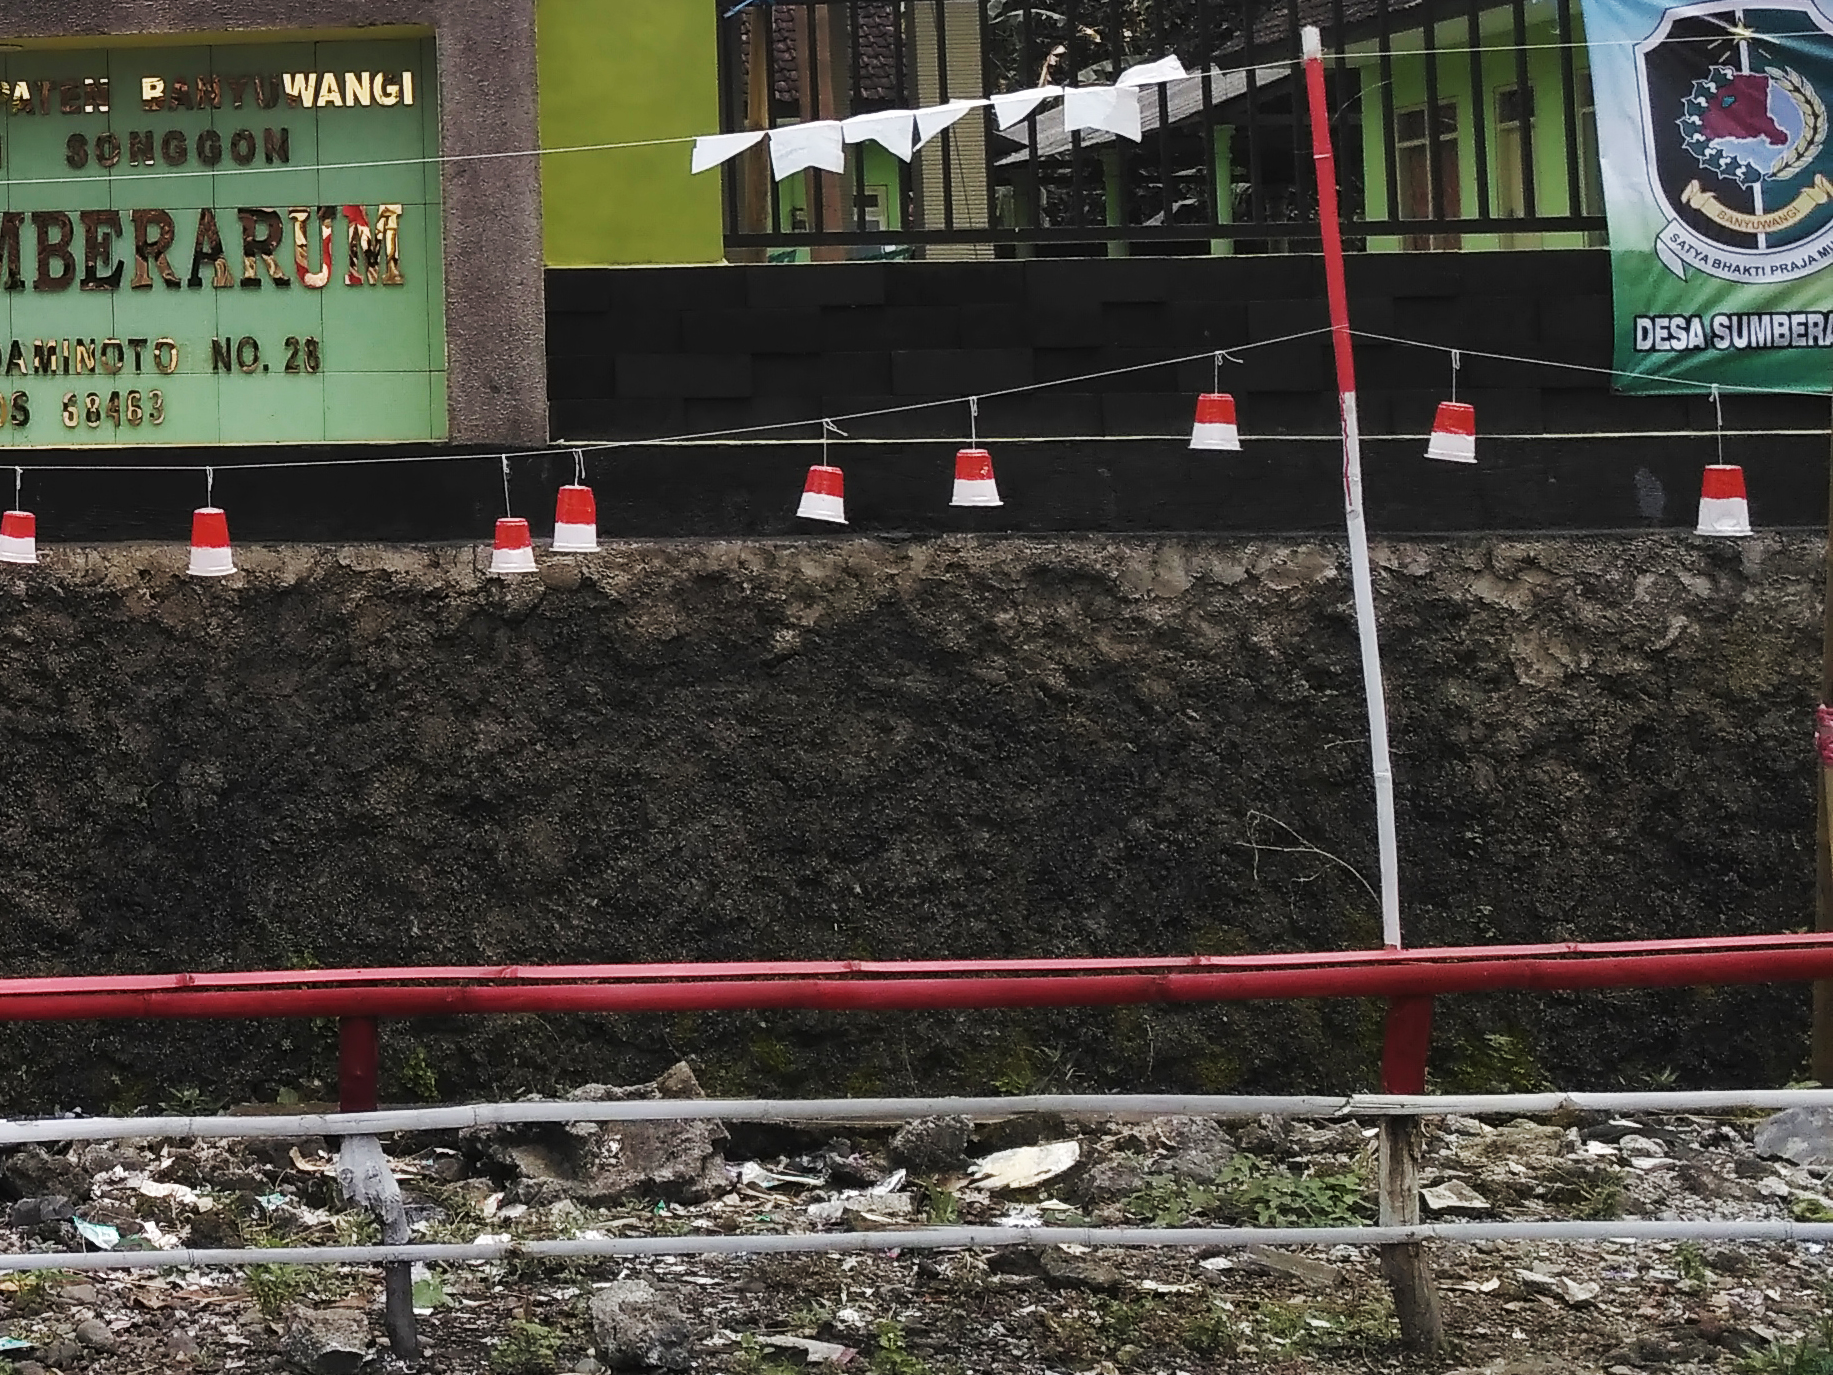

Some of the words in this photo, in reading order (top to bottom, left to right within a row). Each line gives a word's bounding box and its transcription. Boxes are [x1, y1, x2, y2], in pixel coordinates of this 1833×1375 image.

[141, 70, 414, 112] BANYUWANGI
[65, 127, 290, 168] SONGGON
[1716, 205, 1801, 231] BANYUWANGI
[1669, 232, 1709, 265] SATYA
[1711, 258, 1766, 277] BHAKTI
[1770, 255, 1818, 276] PRAJA
[1635, 316, 1706, 352] DESA
[211, 335, 270, 374] NO.
[62, 388, 166, 428] 68463
